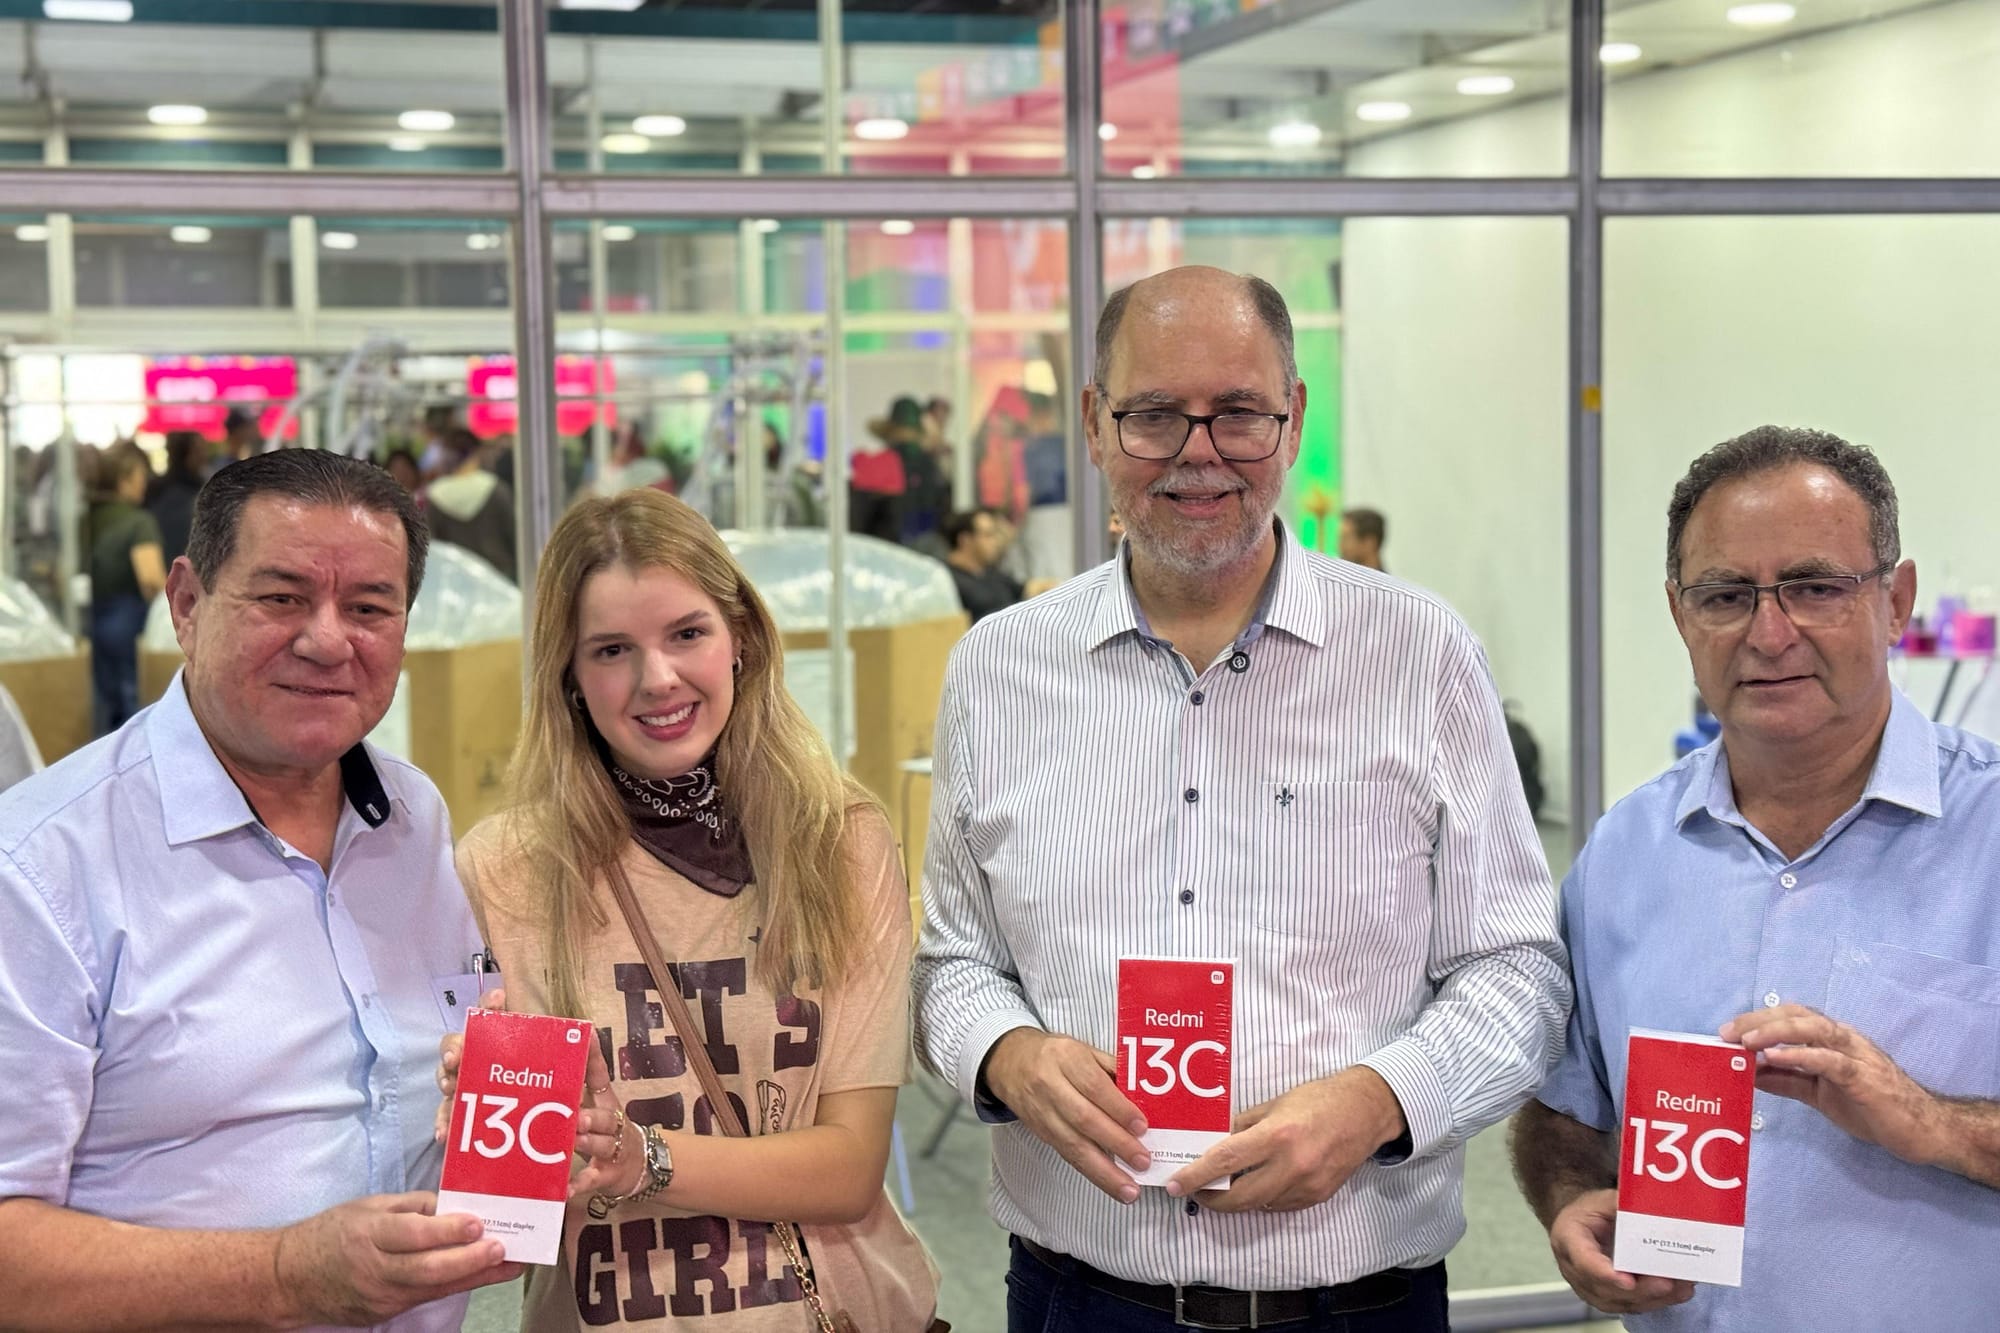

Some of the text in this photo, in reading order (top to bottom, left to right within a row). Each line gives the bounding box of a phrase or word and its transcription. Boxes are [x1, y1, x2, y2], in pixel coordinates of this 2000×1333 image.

[596, 957, 821, 1081] ETS
[1145, 1008, 1204, 1028] Redmi
[488, 1063, 554, 1089] Redmi
[1122, 1036, 1227, 1098] 13C
[1656, 1090, 1722, 1115] Redmi
[459, 1092, 573, 1165] 13C
[1630, 1117, 1745, 1190] 13C
[513, 1222, 535, 1230] display
[575, 1215, 818, 1326] GIRL
[1693, 1245, 1715, 1254] display
